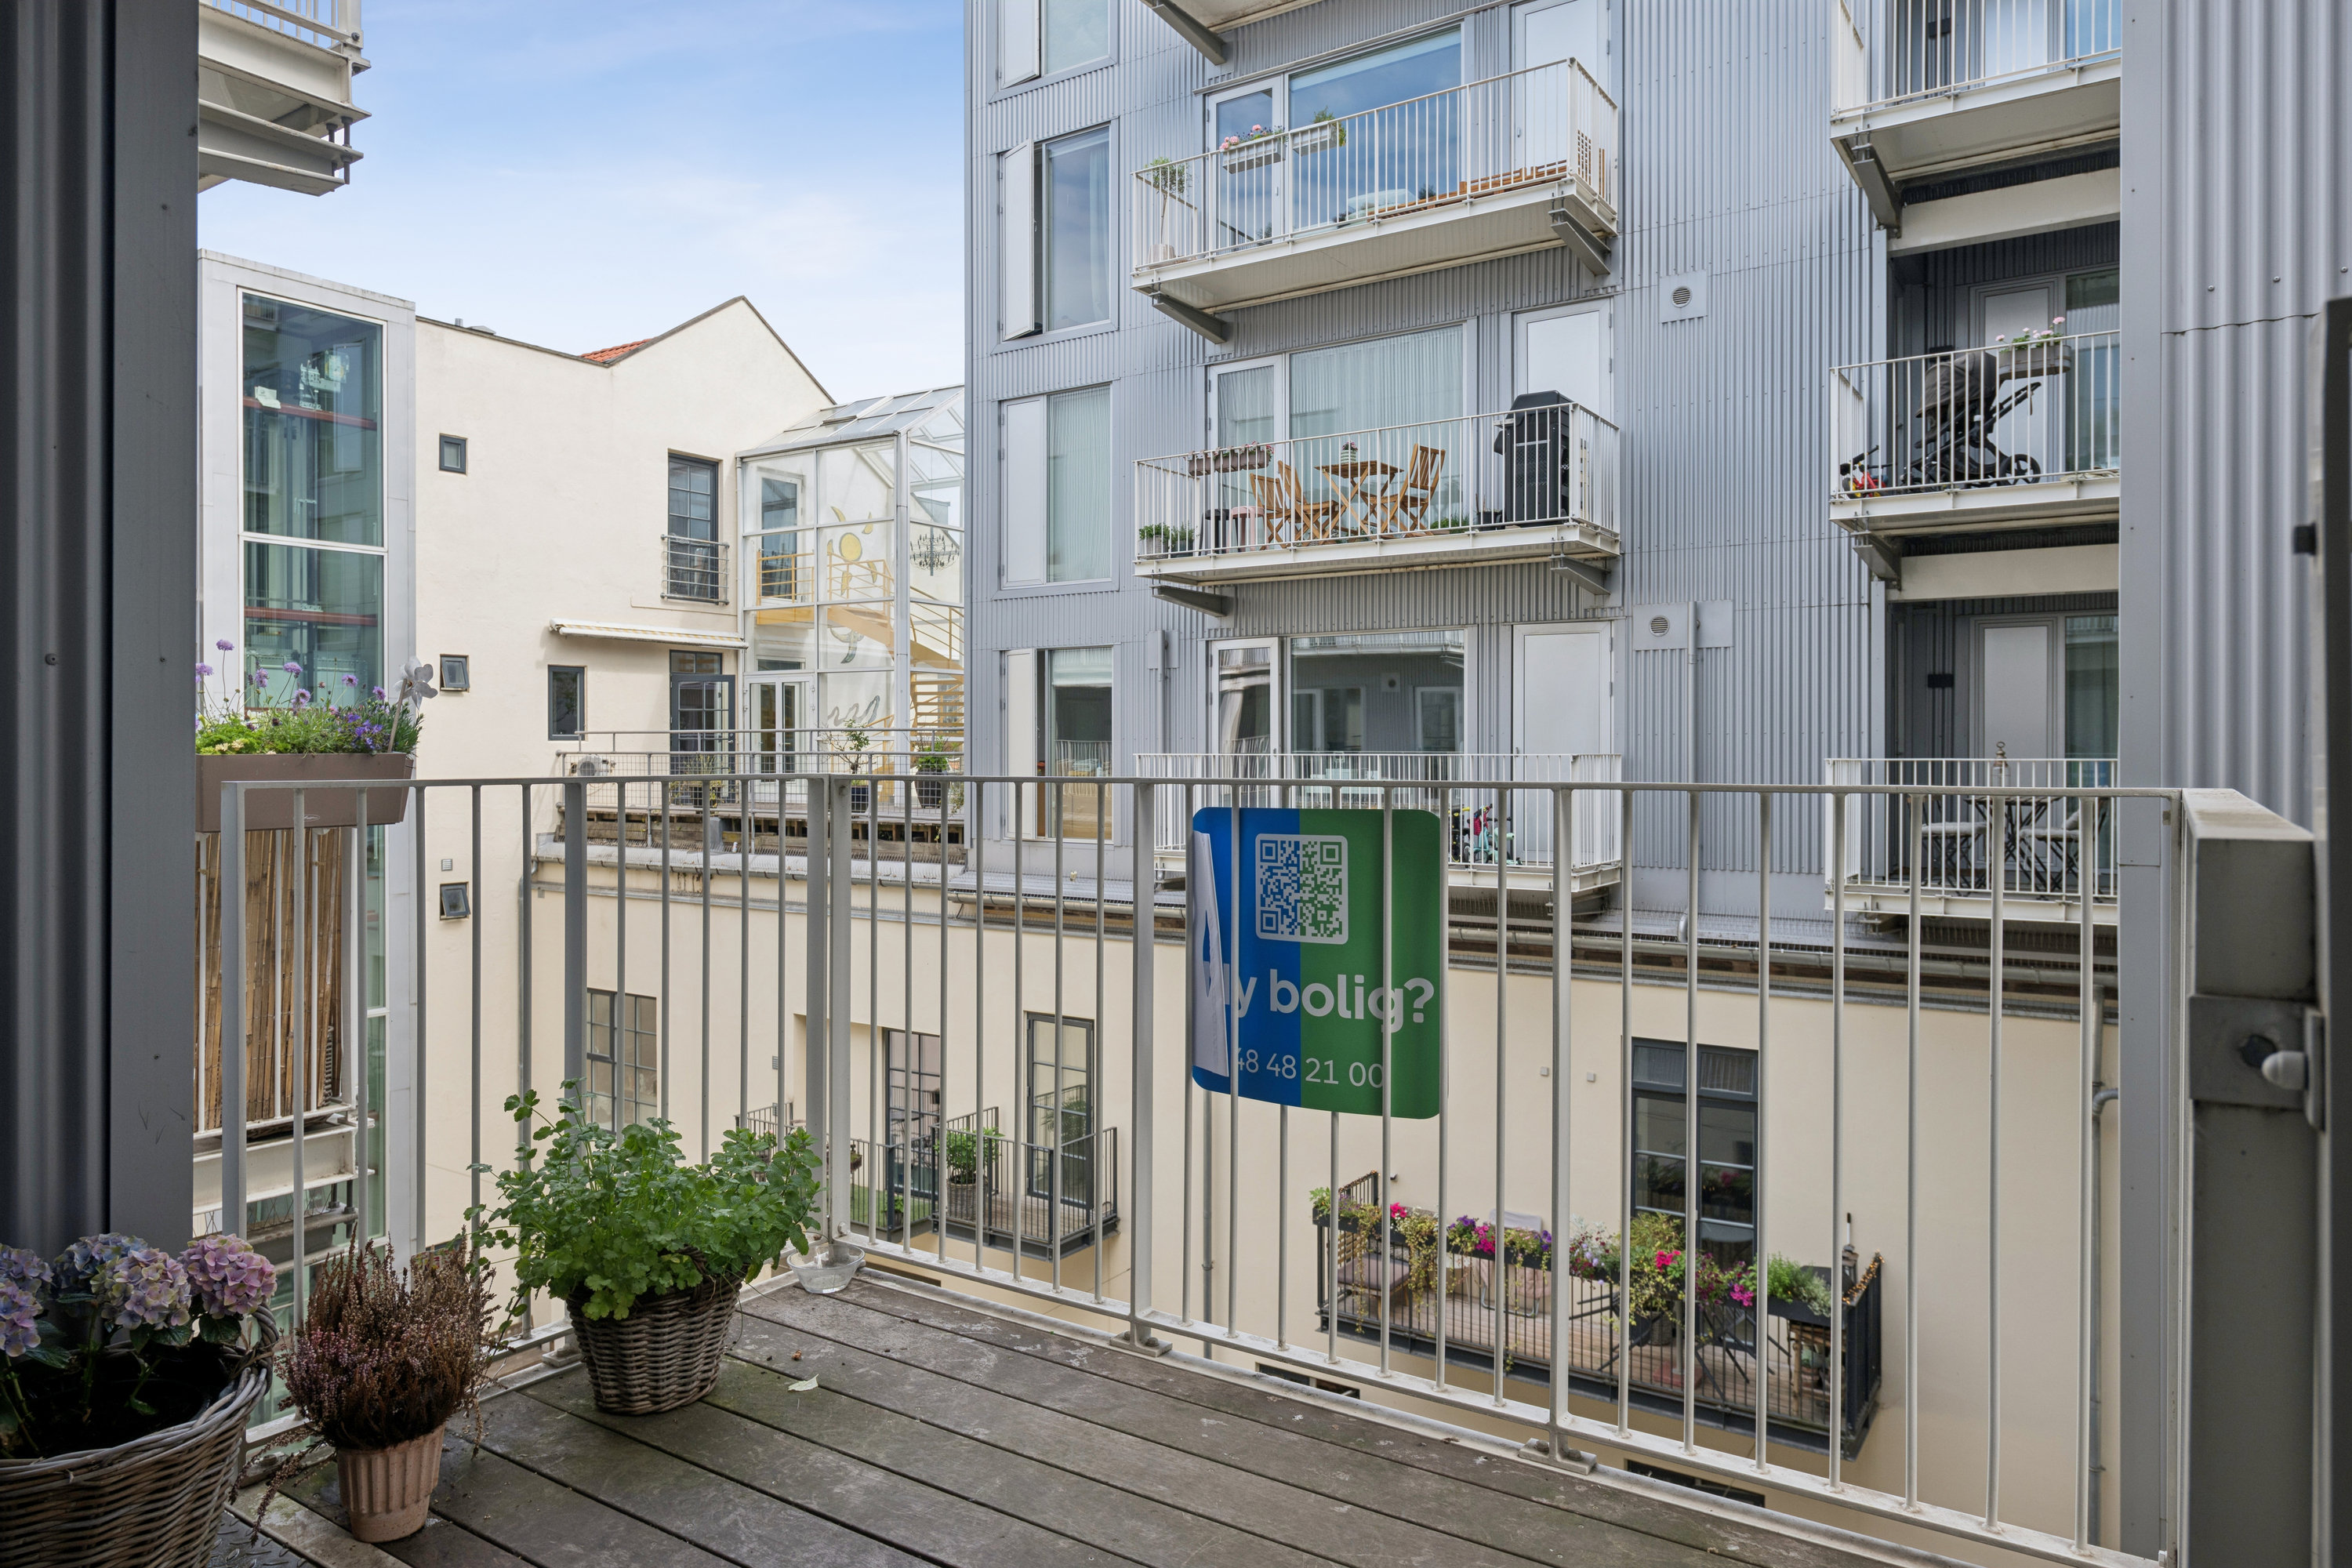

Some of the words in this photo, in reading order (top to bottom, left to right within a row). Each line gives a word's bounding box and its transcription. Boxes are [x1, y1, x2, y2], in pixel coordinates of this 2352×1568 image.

[1269, 968, 1435, 1034] bolig?
[1266, 1053, 1297, 1080] 48
[1305, 1058, 1339, 1085] 21
[1348, 1062, 1384, 1088] 00
